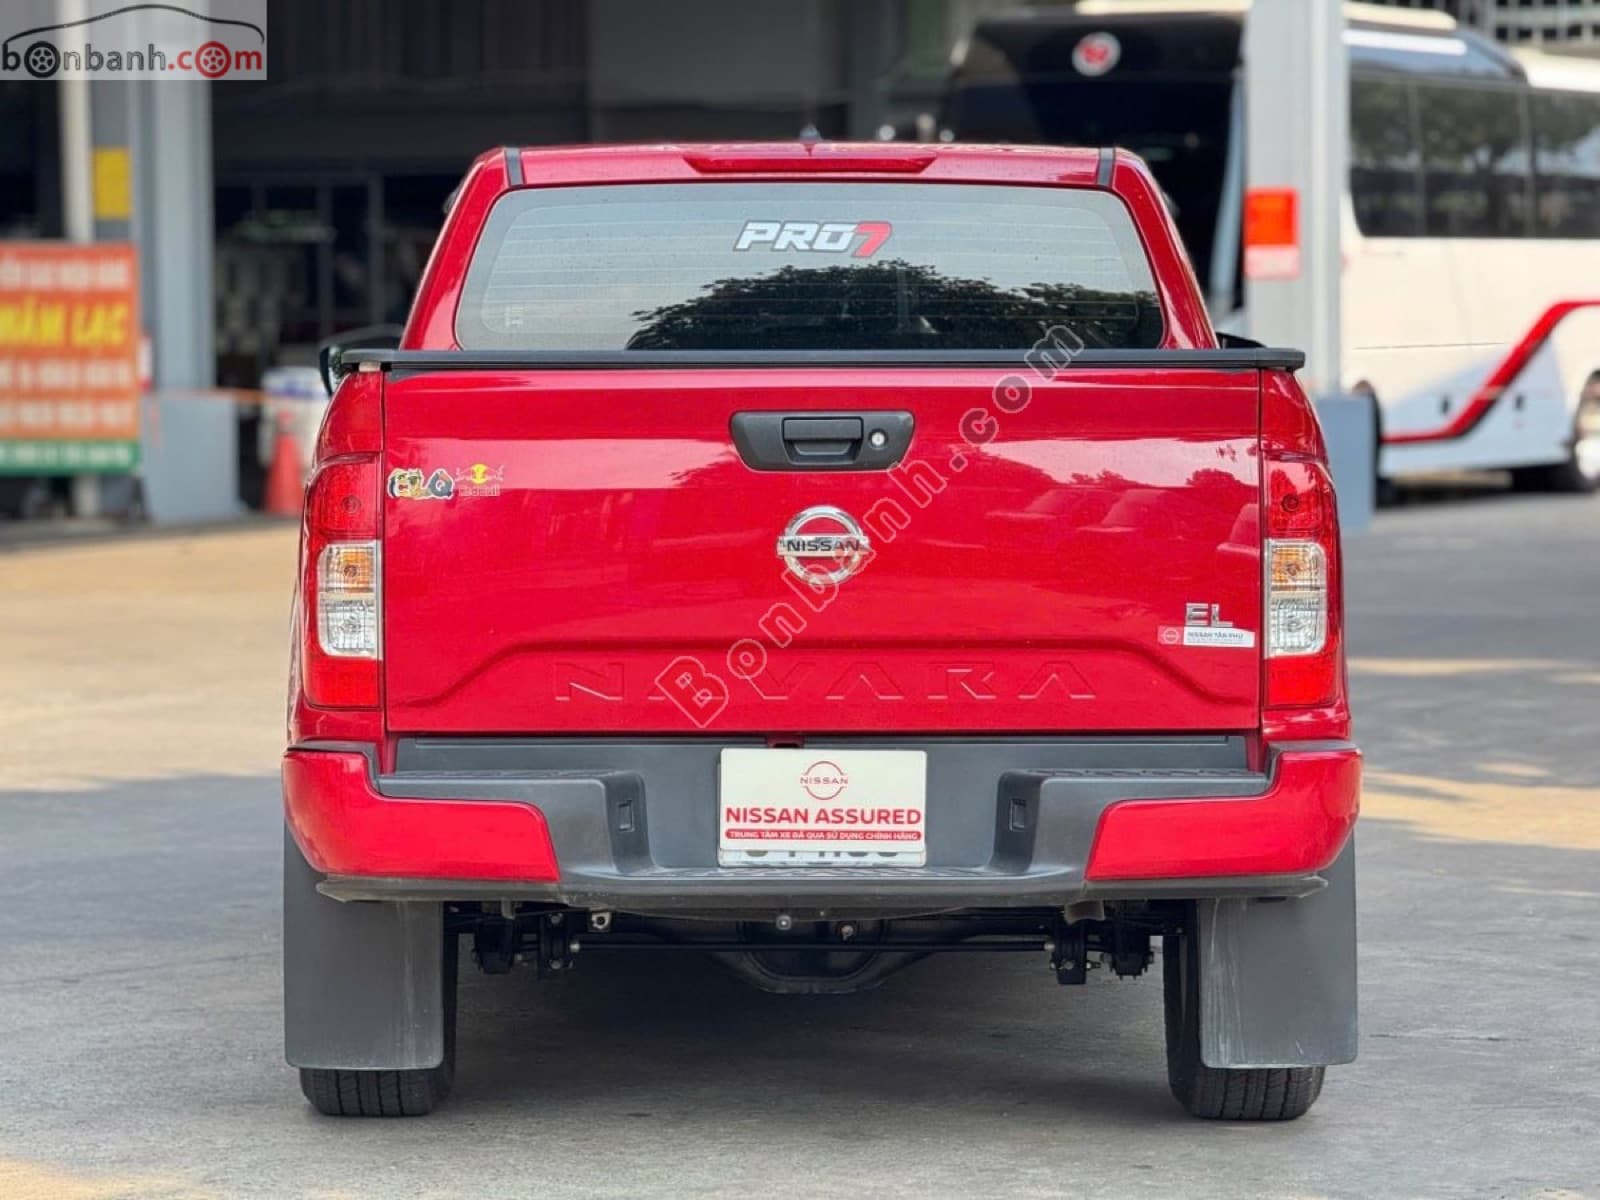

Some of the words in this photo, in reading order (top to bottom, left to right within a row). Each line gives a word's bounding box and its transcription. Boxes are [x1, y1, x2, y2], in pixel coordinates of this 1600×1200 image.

[733, 220, 892, 258] PRO7
[787, 539, 860, 552] NISSAN
[1185, 602, 1233, 628] EL
[554, 661, 1096, 701] NAVARA
[799, 776, 849, 786] NISSAN
[725, 807, 809, 824] NISSAN
[815, 808, 921, 825] ASSURED
[730, 831, 760, 840] TRUNG
[760, 830, 779, 840] TÂM
[779, 831, 791, 840] XE
[806, 831, 825, 841] QUA
